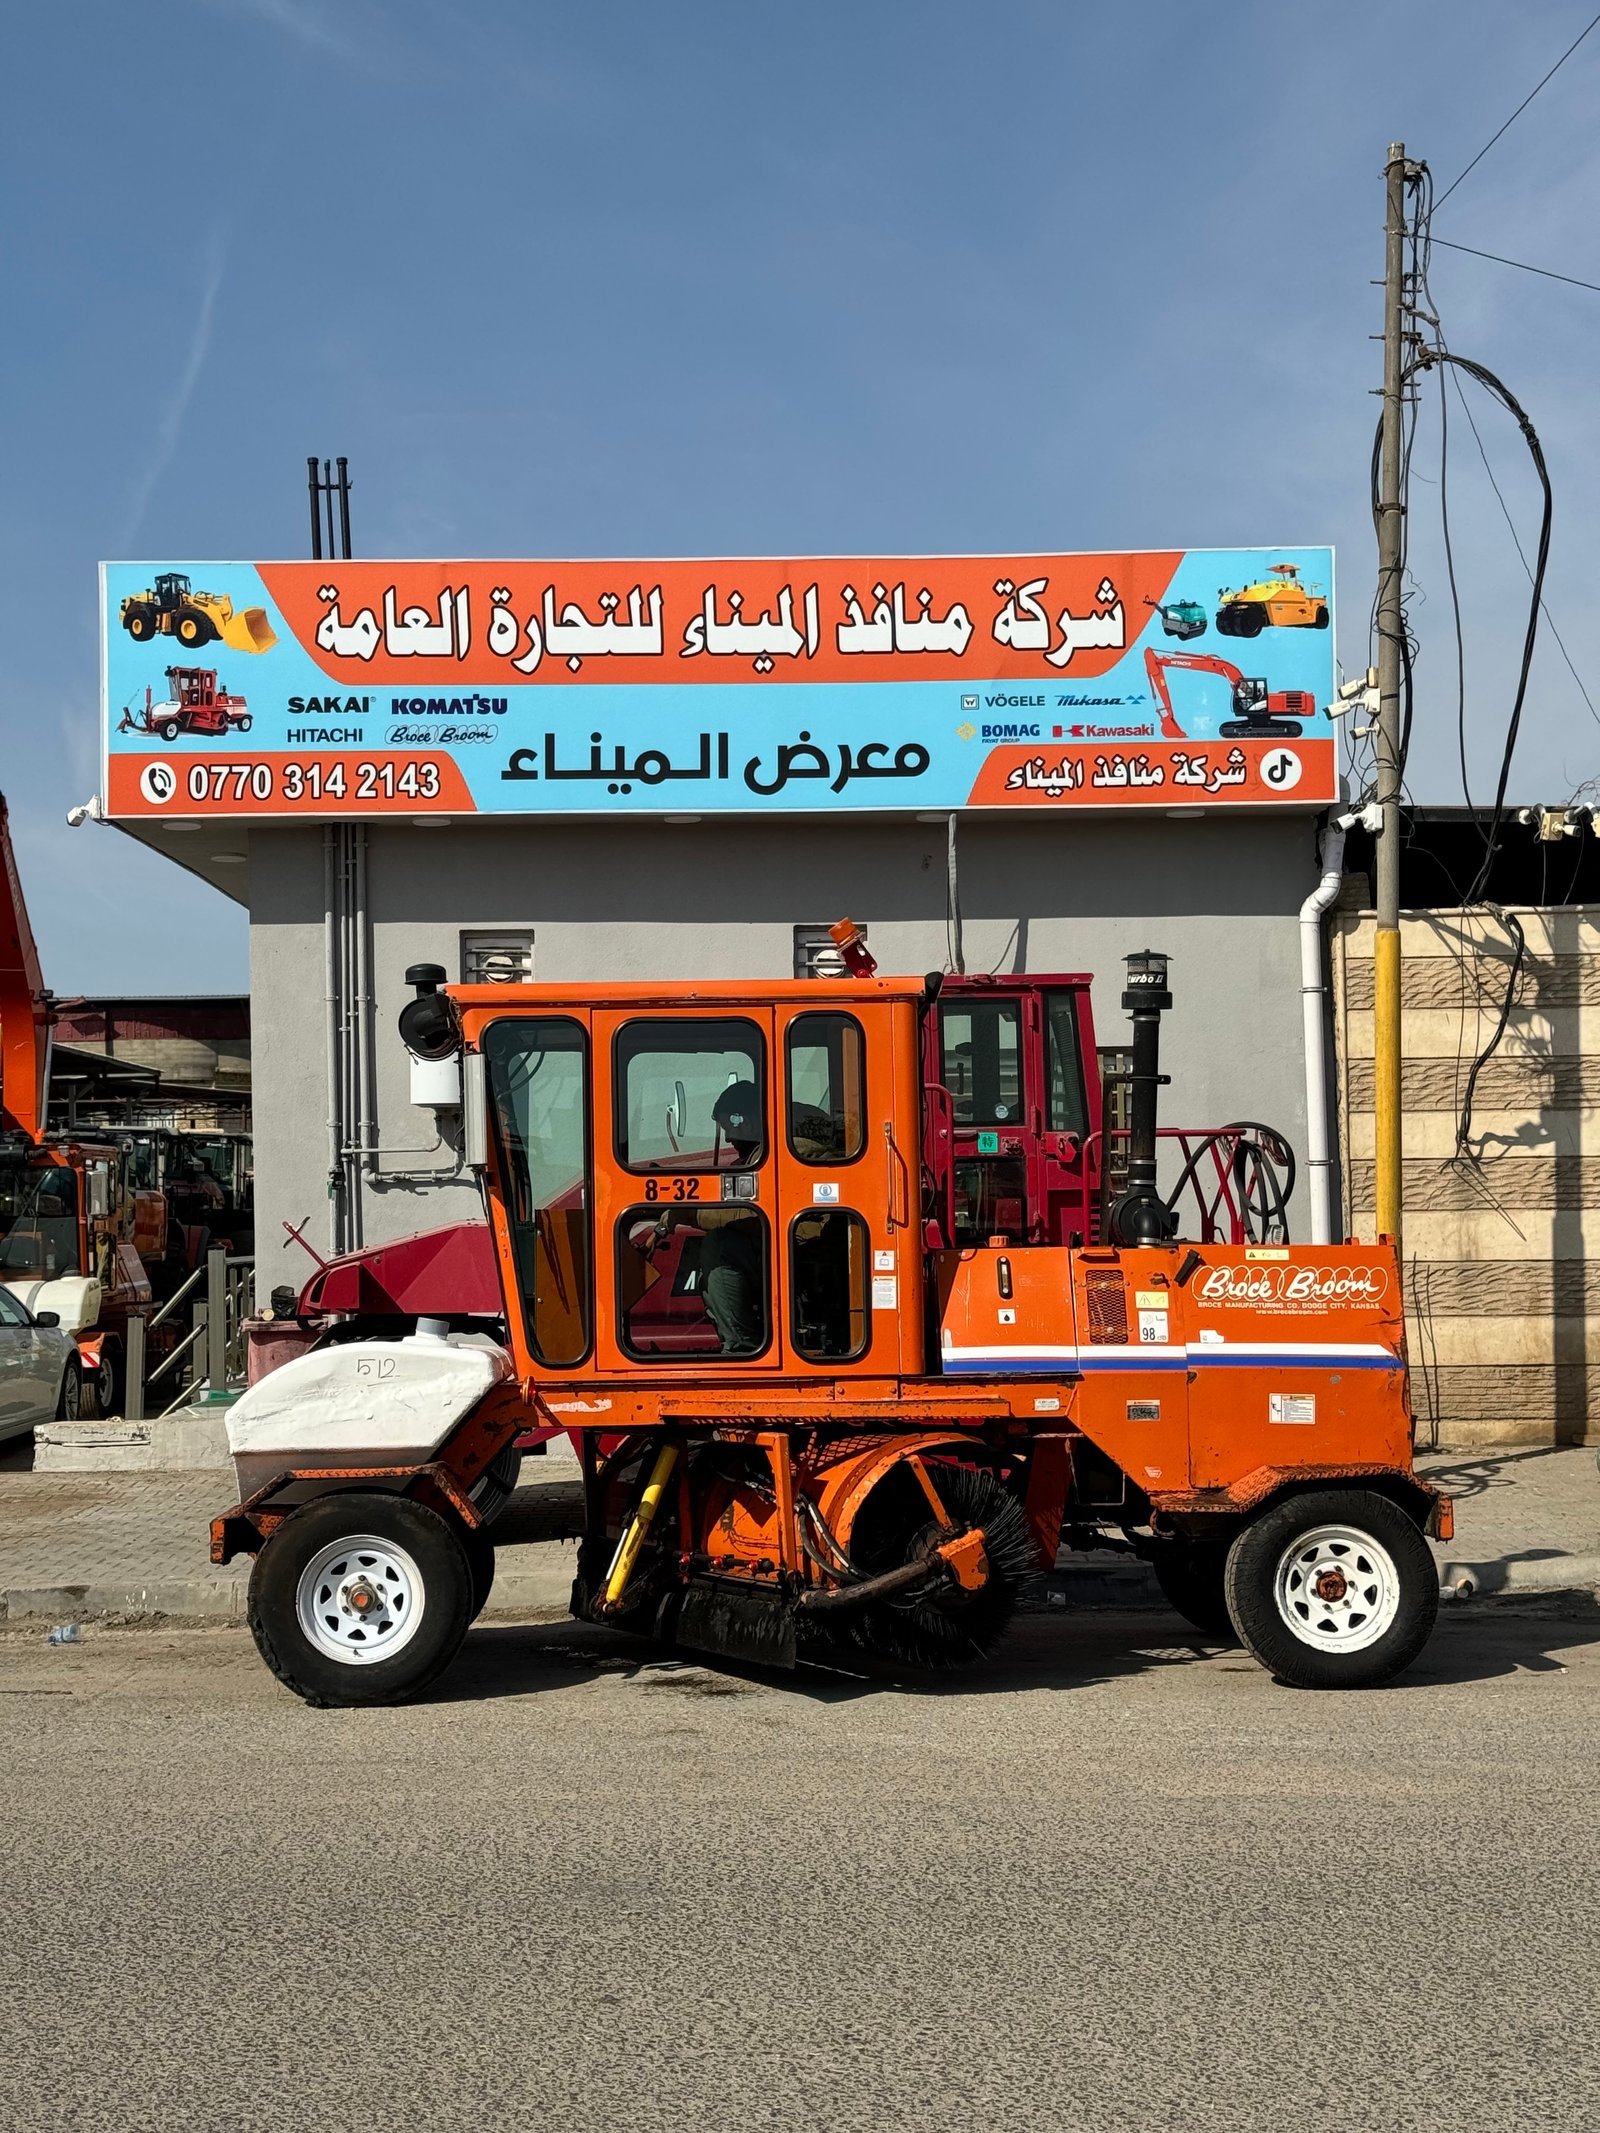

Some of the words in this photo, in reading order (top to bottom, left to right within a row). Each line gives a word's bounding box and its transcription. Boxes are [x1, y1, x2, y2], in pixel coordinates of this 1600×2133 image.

[315, 584, 471, 661] العامة
[487, 584, 664, 675] للتجارة
[679, 583, 818, 674] الميناء
[835, 582, 974, 657] منافذ
[992, 577, 1126, 668] شركة
[391, 693, 508, 715] KOMATSU
[985, 693, 1046, 707] VÖGELE
[1054, 695, 1126, 706] Mikasa
[287, 728, 363, 743] HITACHI
[390, 726, 432, 743] Broce
[437, 727, 493, 742] Broom
[981, 723, 1040, 737] BOMAG
[1086, 723, 1155, 737] Kawasaki
[501, 732, 729, 794] الميناء
[743, 730, 930, 795] معرض
[1005, 756, 1083, 798] الميناء
[1091, 755, 1165, 789] منافذ
[1174, 748, 1247, 793] شركة
[188, 763, 273, 801] 0770
[283, 763, 346, 800] 314
[356, 761, 441, 799] 2143
[1128, 974, 1154, 984] turbo
[644, 1178, 700, 1201] 8-32
[1201, 1268, 1273, 1299] Broce
[1286, 1271, 1380, 1299] Broom
[1330, 1302, 1348, 1310] CITY,
[1142, 1327, 1156, 1341] 98
